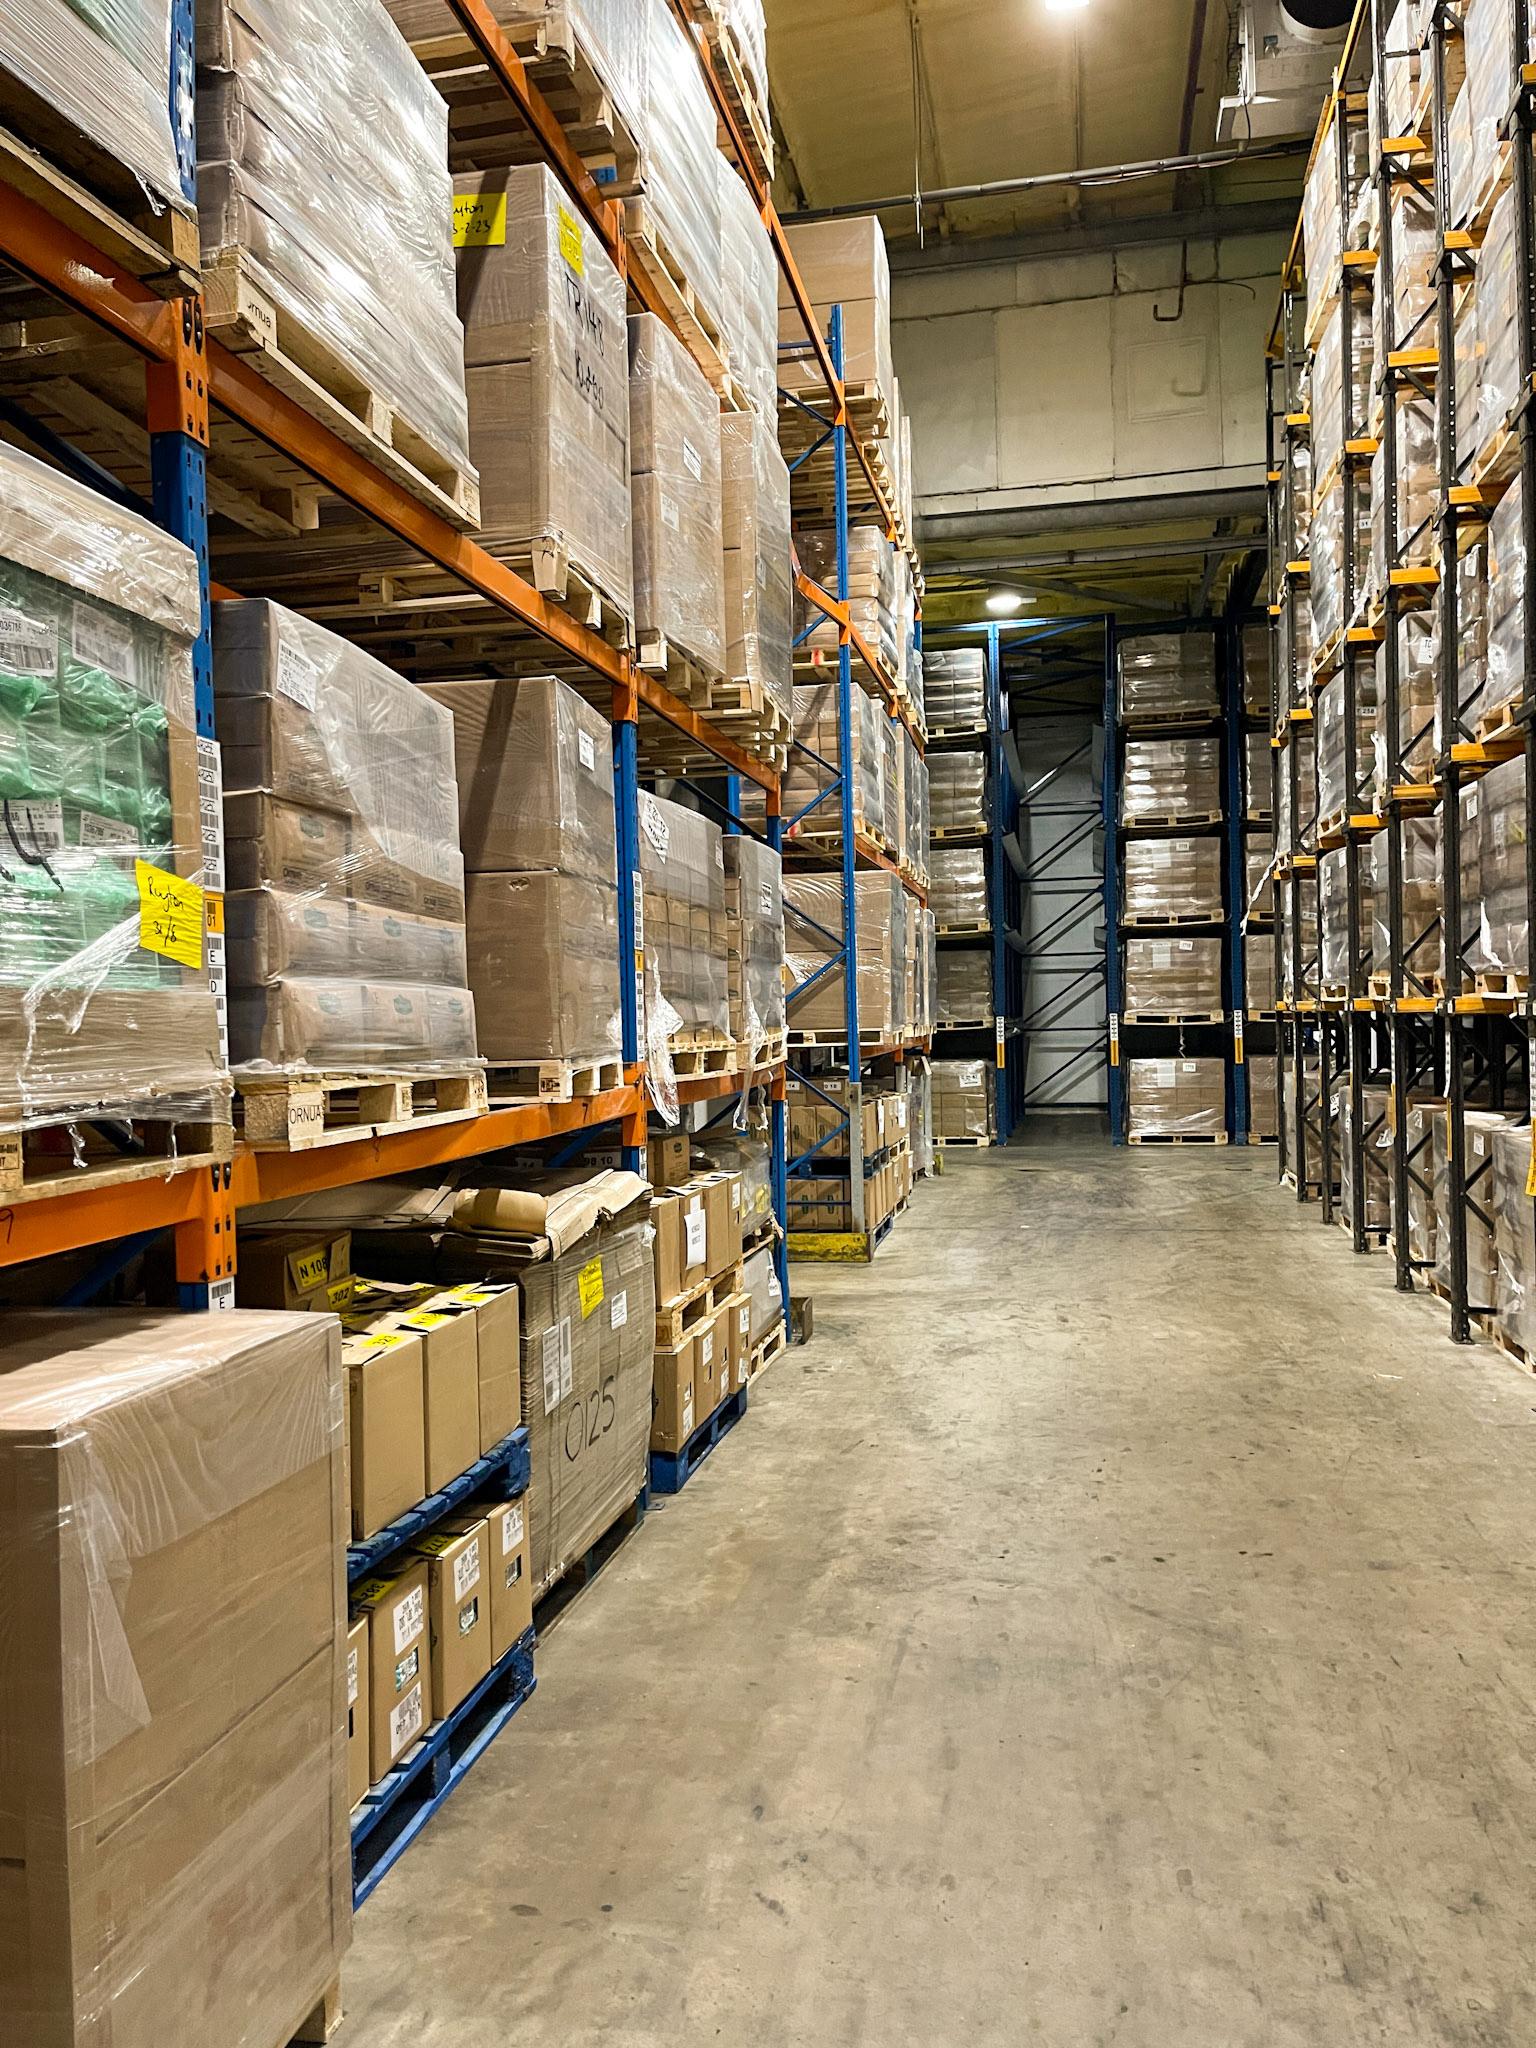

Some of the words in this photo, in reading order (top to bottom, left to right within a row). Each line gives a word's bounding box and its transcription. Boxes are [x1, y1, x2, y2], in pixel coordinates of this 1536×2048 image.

[207, 914, 216, 927] 01
[210, 950, 216, 963] E
[211, 980, 217, 993] D
[289, 1105, 322, 1126] ORNUA
[600, 1155, 613, 1165] 10
[299, 1264, 309, 1279] N
[310, 1257, 328, 1275] 108
[219, 1296, 226, 1309] E
[331, 1287, 350, 1305] 302
[565, 1375, 615, 1462] 0125
